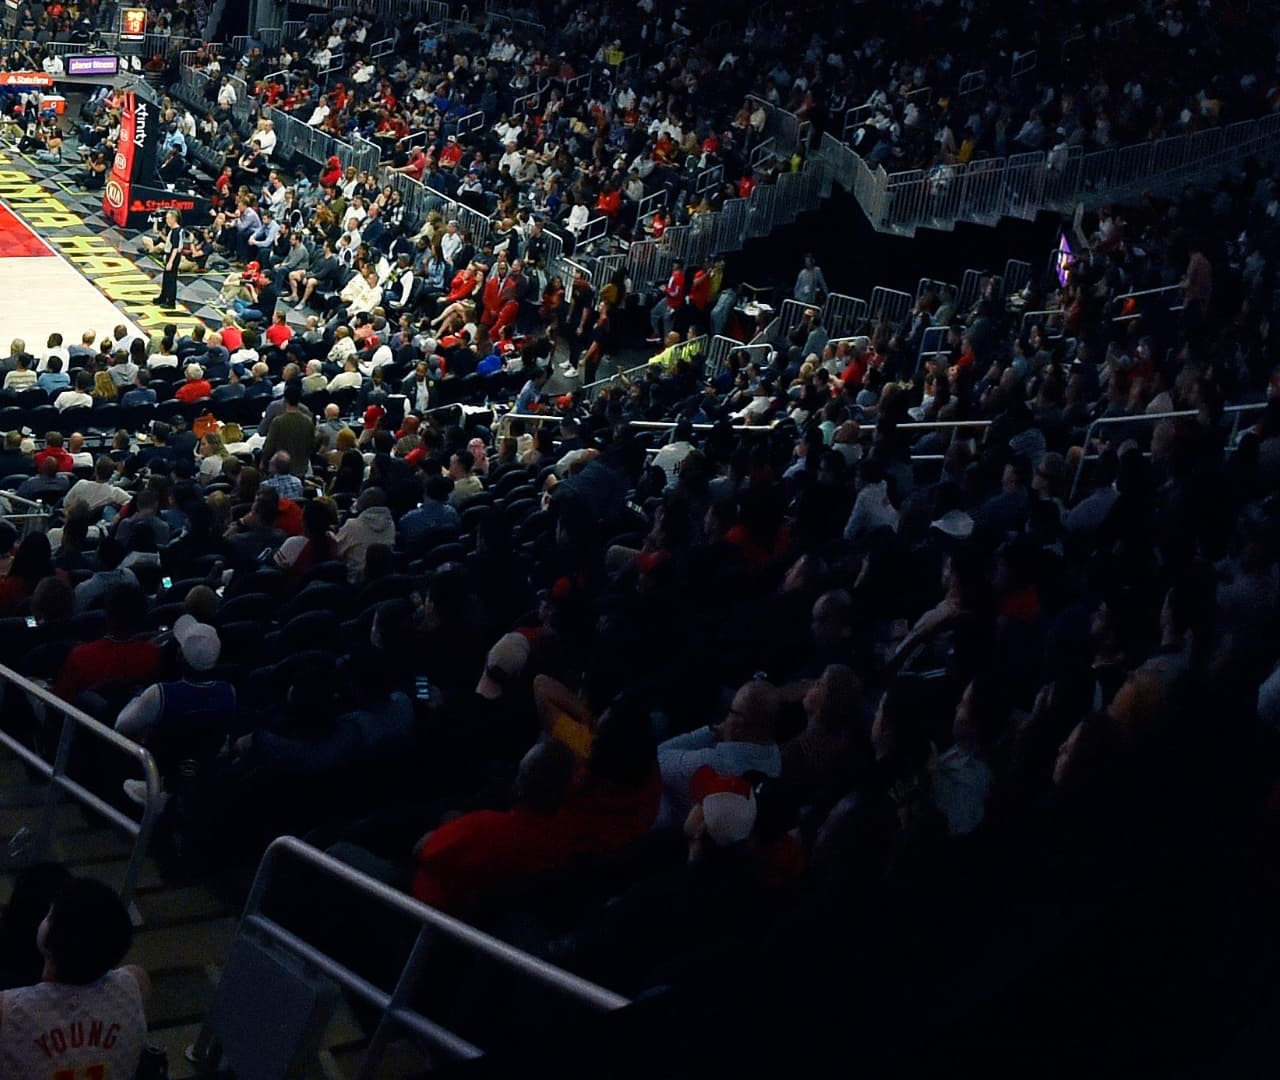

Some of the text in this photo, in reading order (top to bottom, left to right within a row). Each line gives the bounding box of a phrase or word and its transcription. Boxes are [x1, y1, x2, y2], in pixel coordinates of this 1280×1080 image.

[133, 103, 149, 148] xfinity
[108, 187, 121, 204] KIA
[146, 200, 194, 211] State Farm
[35, 1022, 122, 1058] YOUNG
